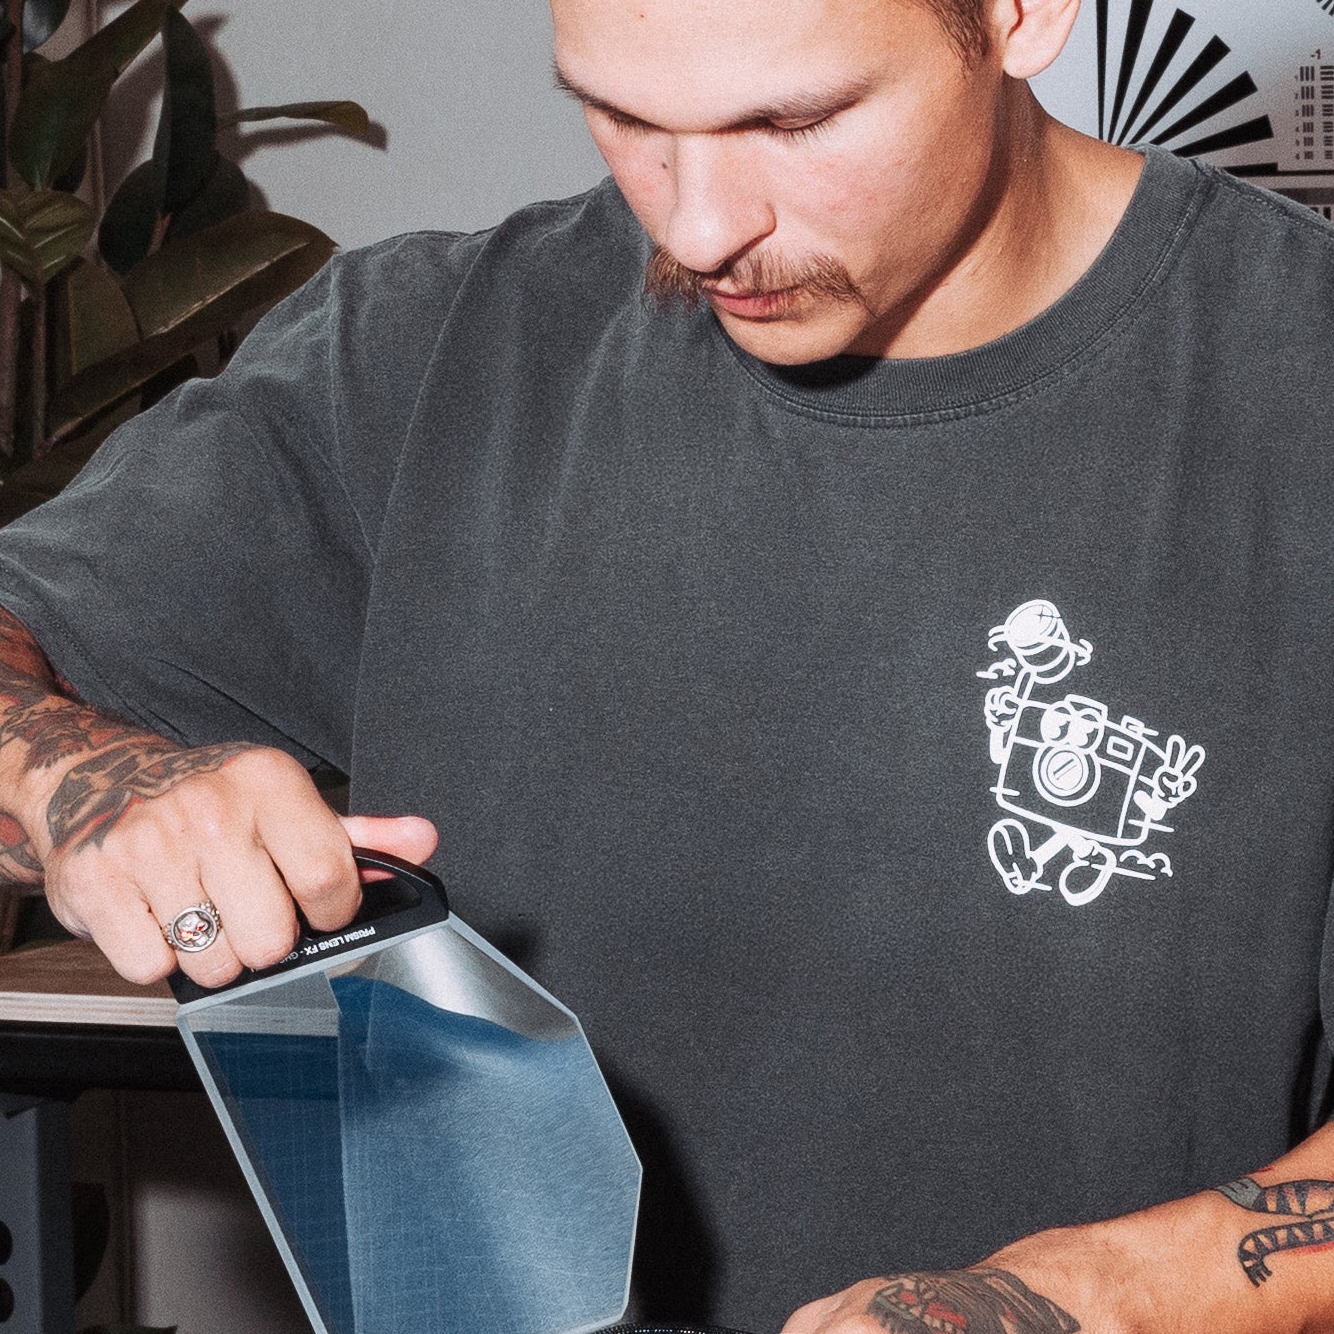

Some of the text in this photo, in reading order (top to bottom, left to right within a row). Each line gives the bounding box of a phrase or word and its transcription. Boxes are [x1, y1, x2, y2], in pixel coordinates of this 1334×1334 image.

[344, 926, 376, 943] PRISM
[304, 944, 319, 955] FX
[318, 937, 345, 951] LENS
